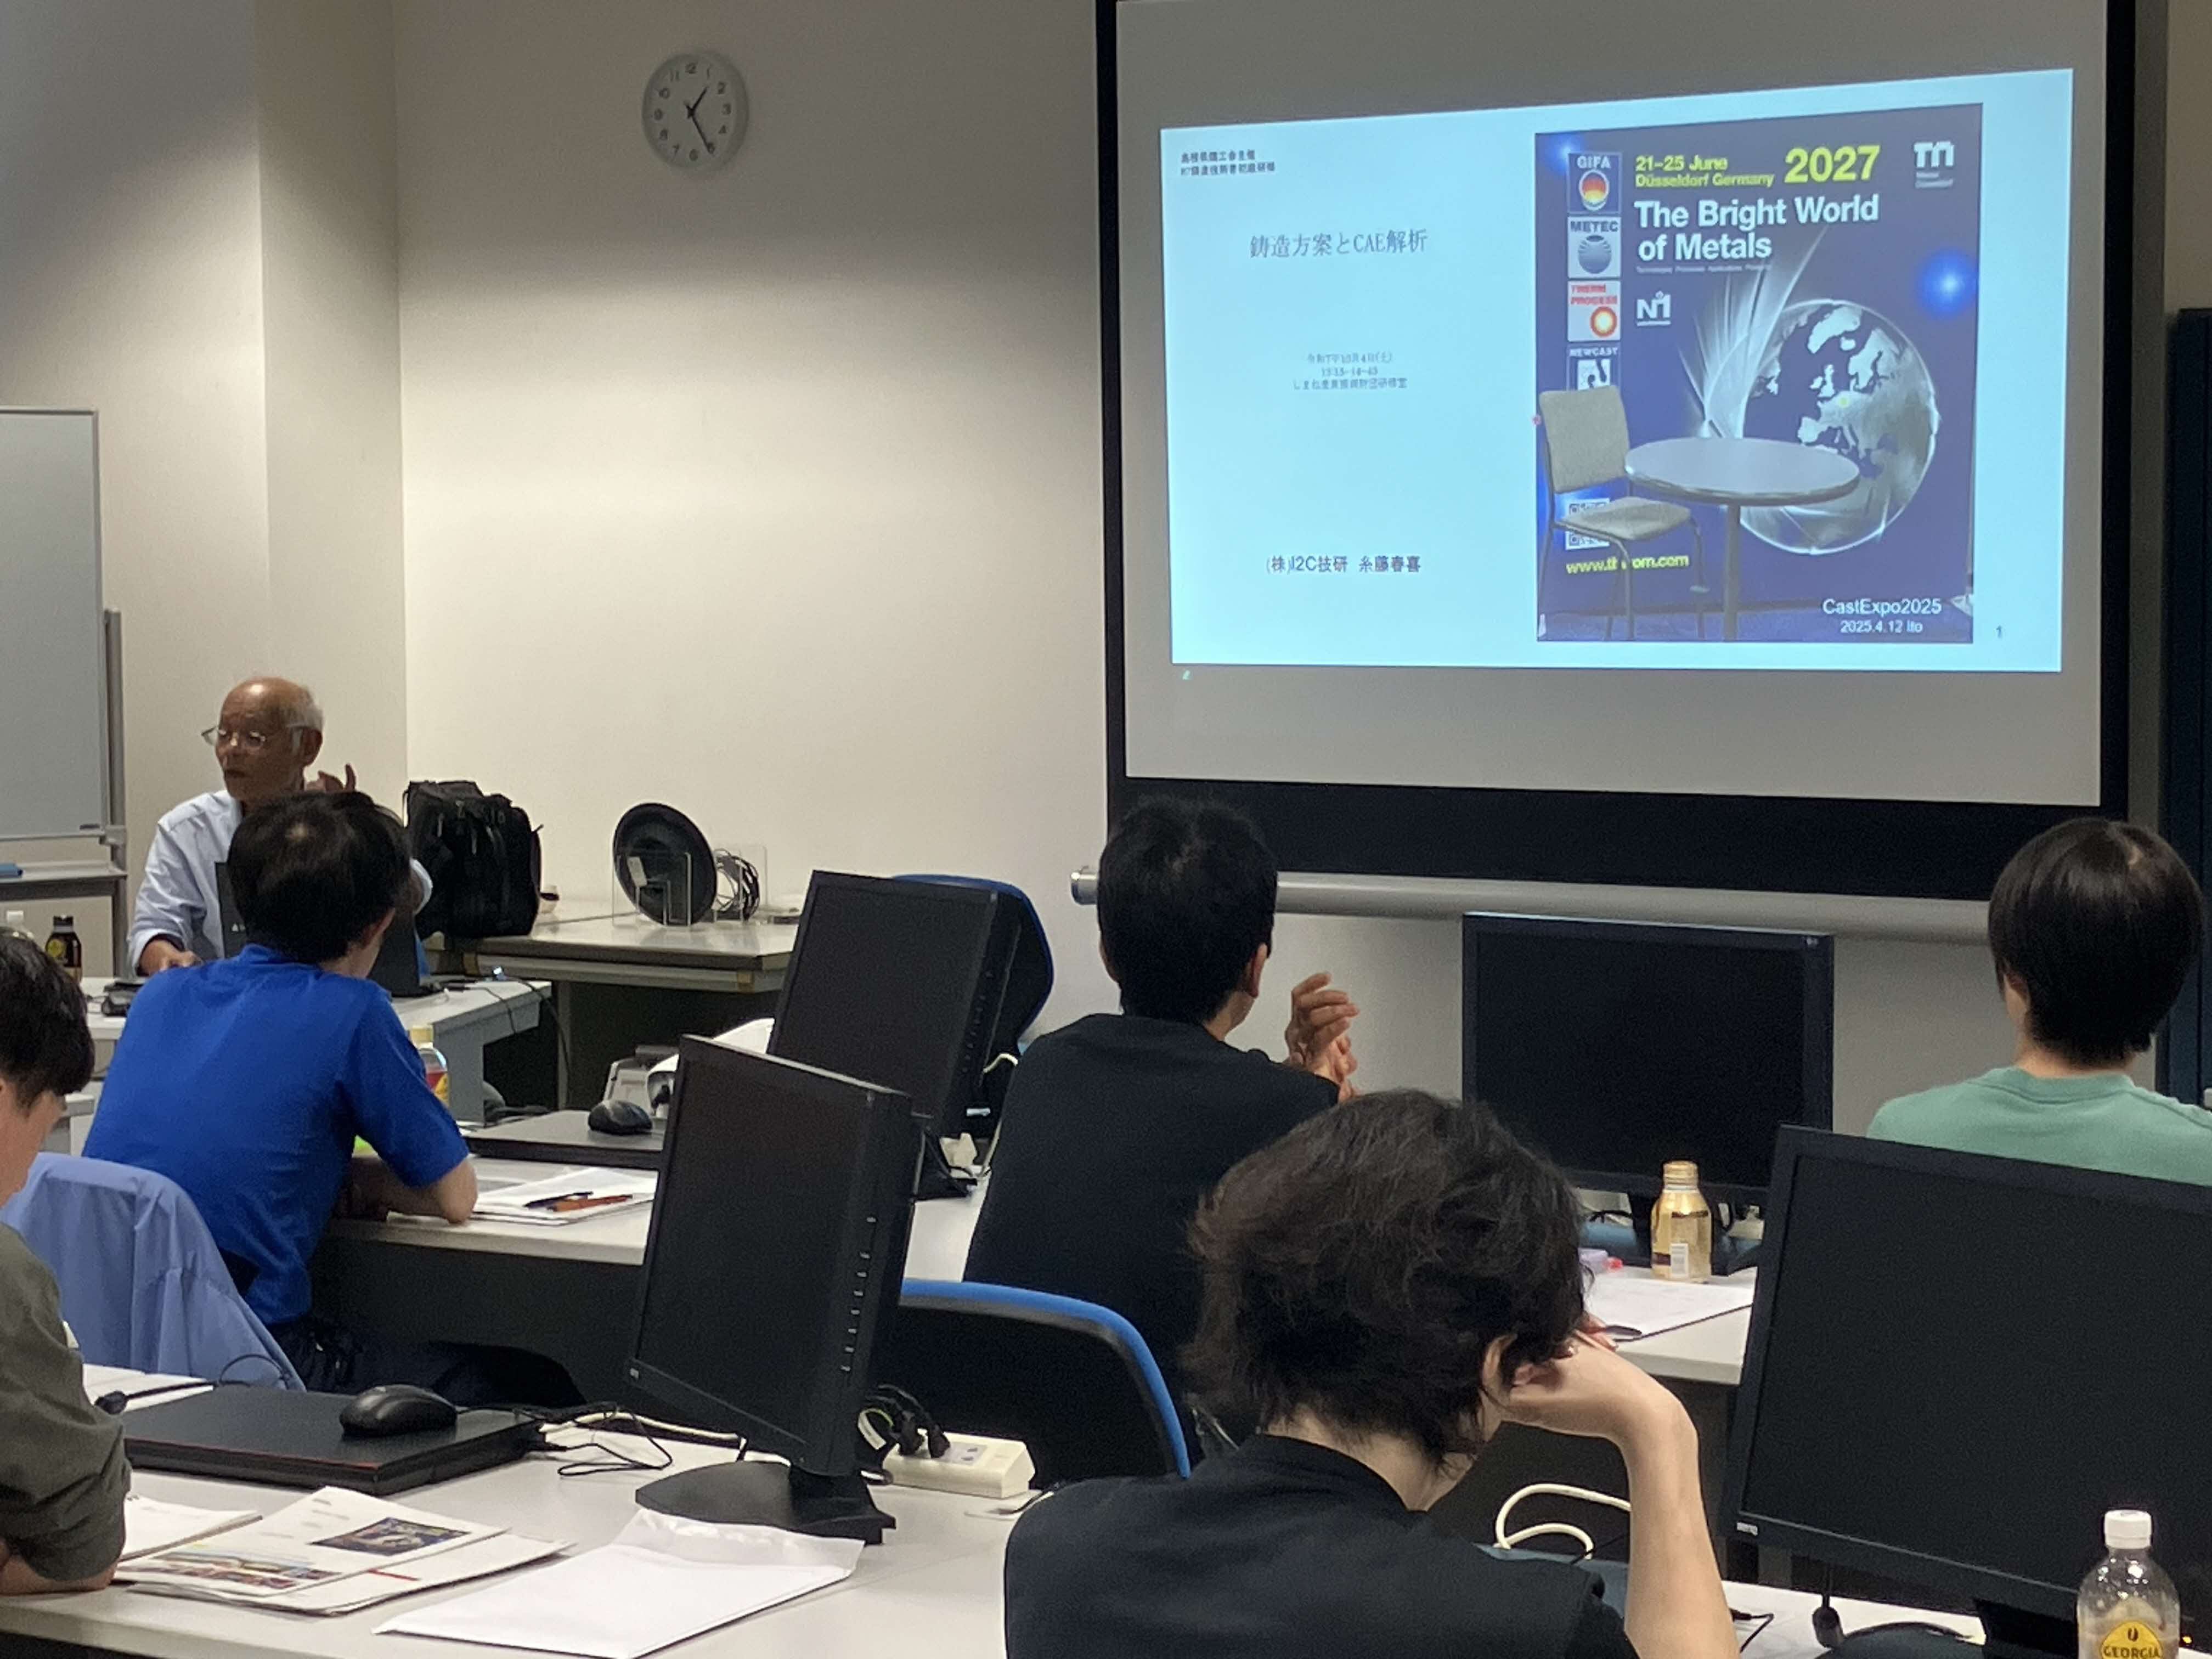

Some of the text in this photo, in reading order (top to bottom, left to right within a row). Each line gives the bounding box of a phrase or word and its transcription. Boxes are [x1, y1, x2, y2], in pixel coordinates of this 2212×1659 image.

[1577, 156, 1611, 168] GIFA
[1689, 154, 1728, 171] June
[1784, 145, 1881, 183] 2027
[1635, 172, 1775, 188] Düsseldorf Germany
[1634, 193, 1880, 232] The Bright World
[1571, 221, 1619, 233] METEC
[1250, 229, 1427, 258] 鋳造方案とCAE解析
[1638, 233, 1773, 261] of Metals
[1569, 347, 1618, 357] NEWCAST
[1822, 597, 1943, 617] CastExpo2025
[1840, 620, 1902, 633] 2025.4.12
[1995, 624, 2002, 638] 1
[2103, 1645, 2160, 1658] GEORGIA
